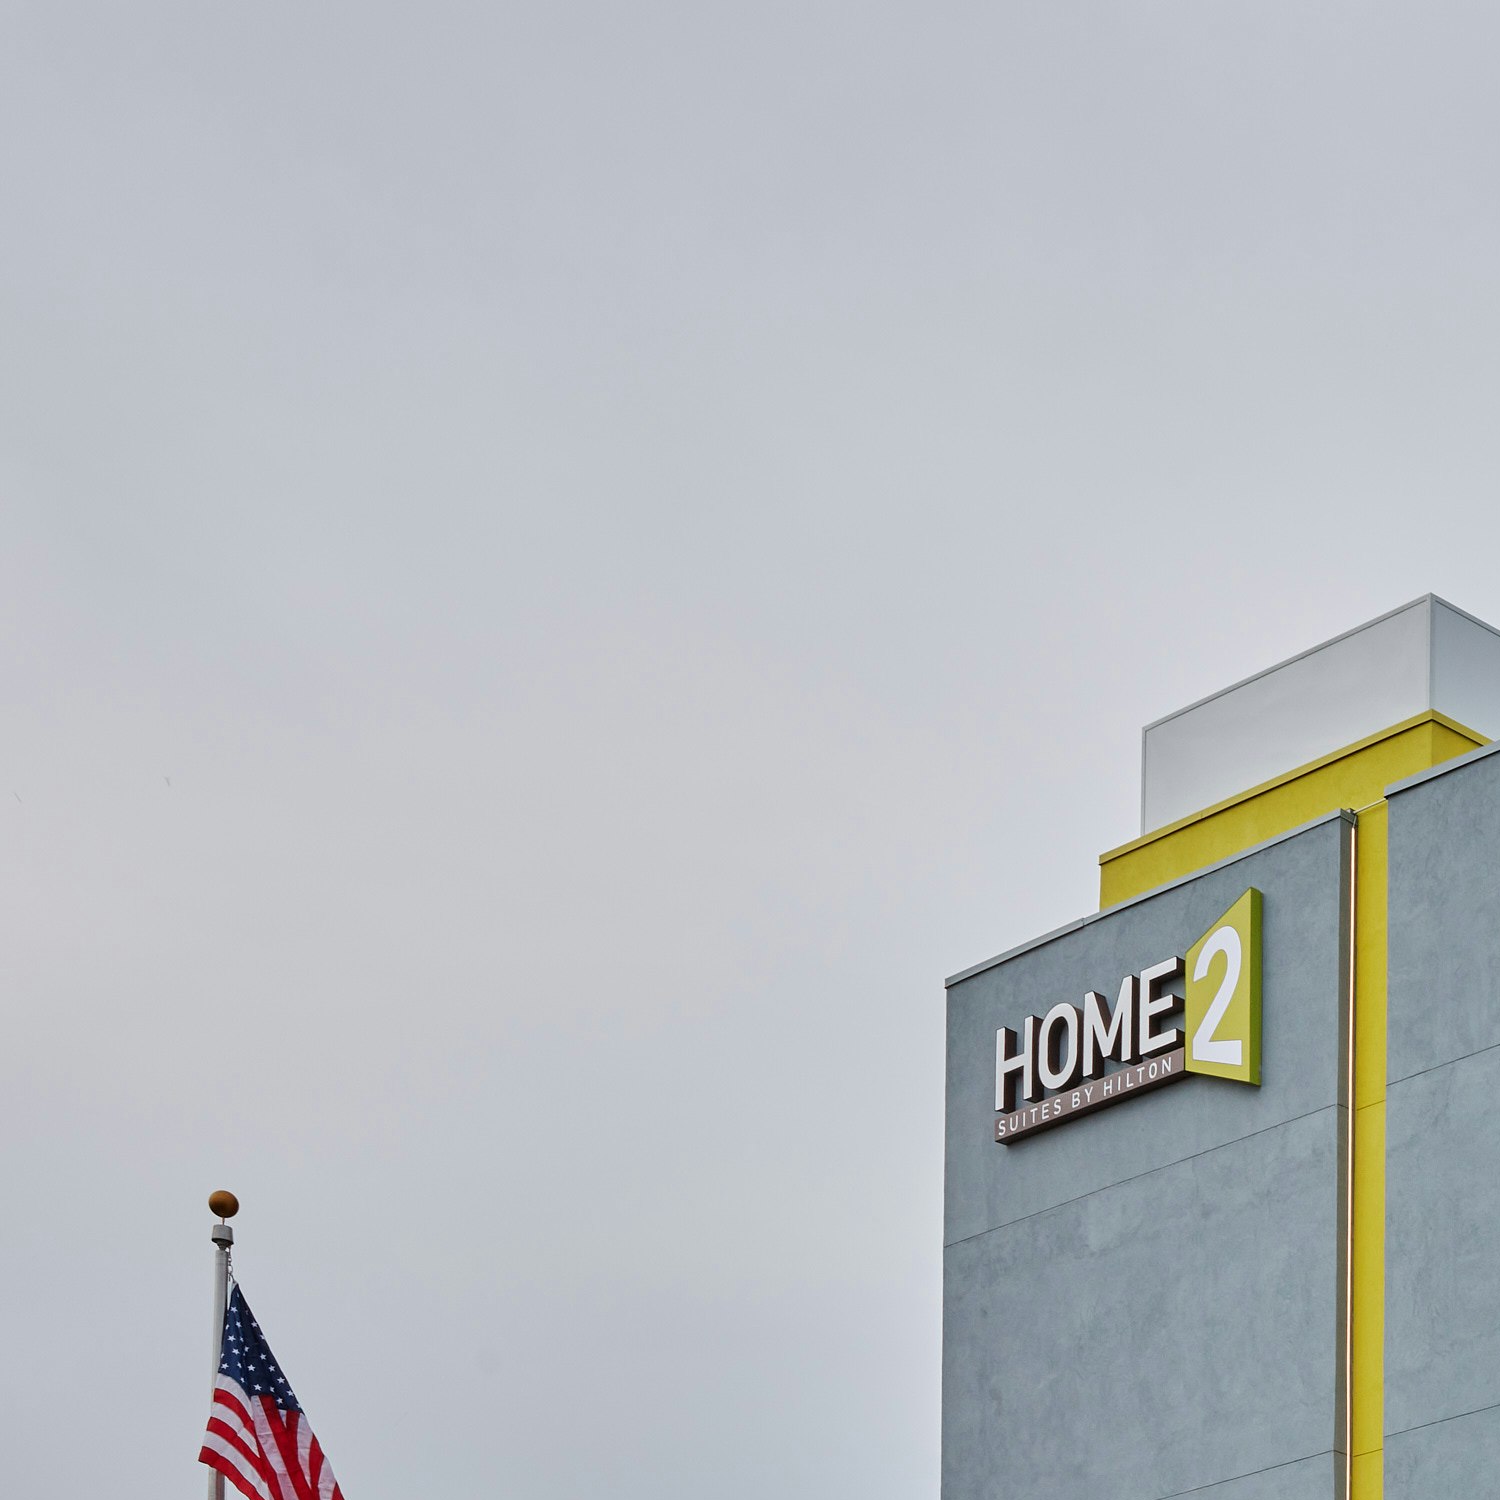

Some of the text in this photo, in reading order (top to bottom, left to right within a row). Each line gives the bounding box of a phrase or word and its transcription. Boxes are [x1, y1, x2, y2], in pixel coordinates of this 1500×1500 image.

[995, 925, 1243, 1112] HOME 2
[998, 1056, 1173, 1136] SUITES BY HILTON
